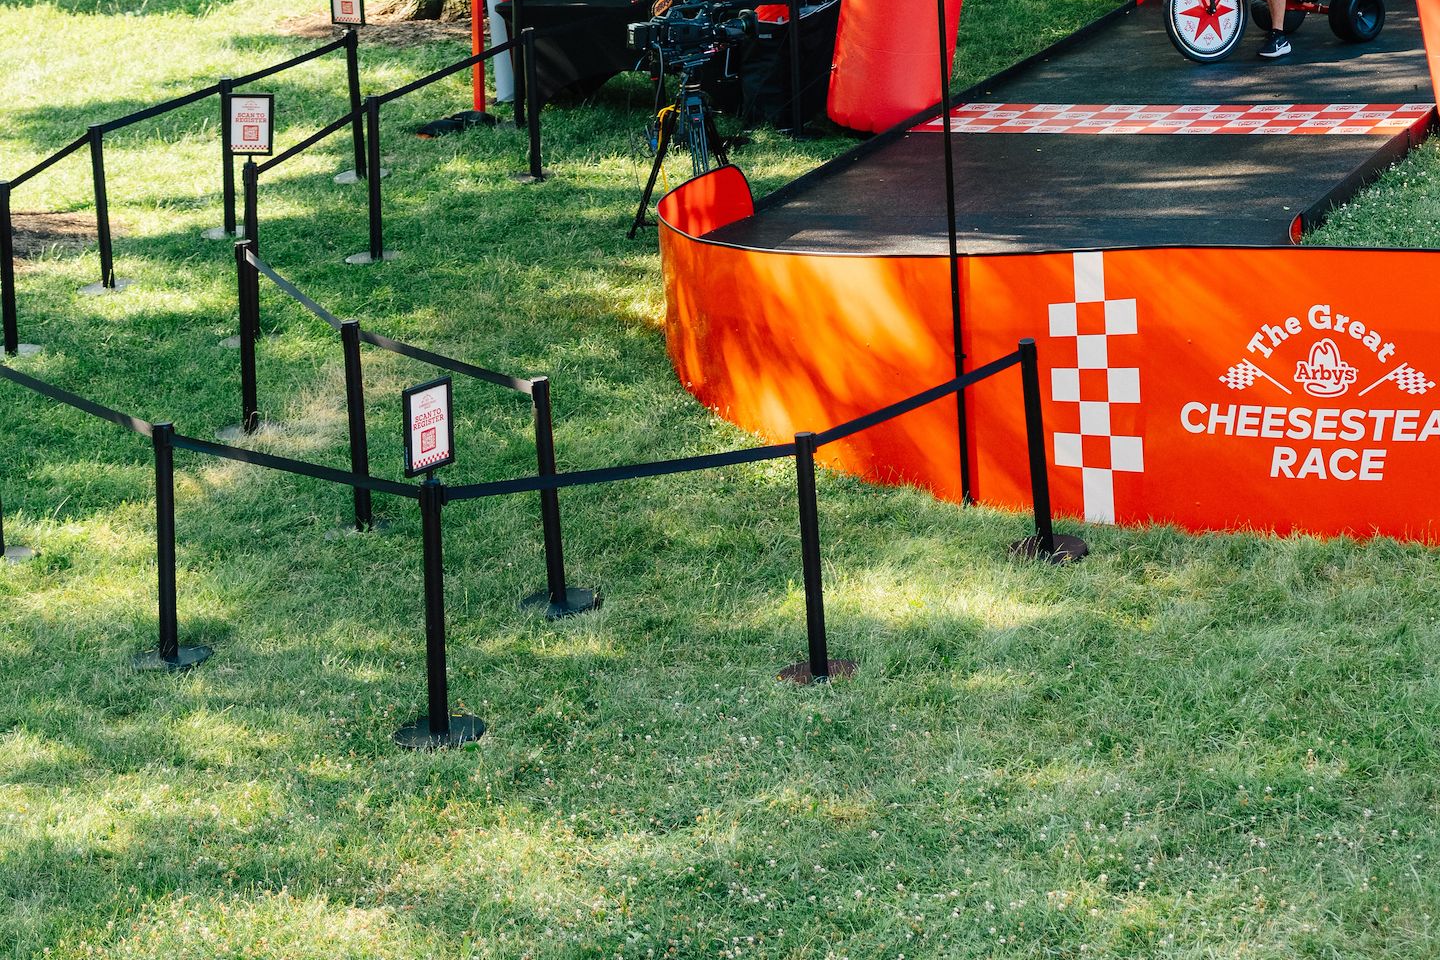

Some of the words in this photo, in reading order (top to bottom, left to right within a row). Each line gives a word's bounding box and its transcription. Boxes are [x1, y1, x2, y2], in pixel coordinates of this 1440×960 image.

[1246, 315, 1303, 360] The
[1307, 303, 1396, 364] Great
[1295, 362, 1357, 384] Arby's
[413, 414, 444, 431] REGISTER
[414, 411, 433, 423] SCAN
[433, 407, 442, 417] TO
[1269, 446, 1388, 481] RACE
